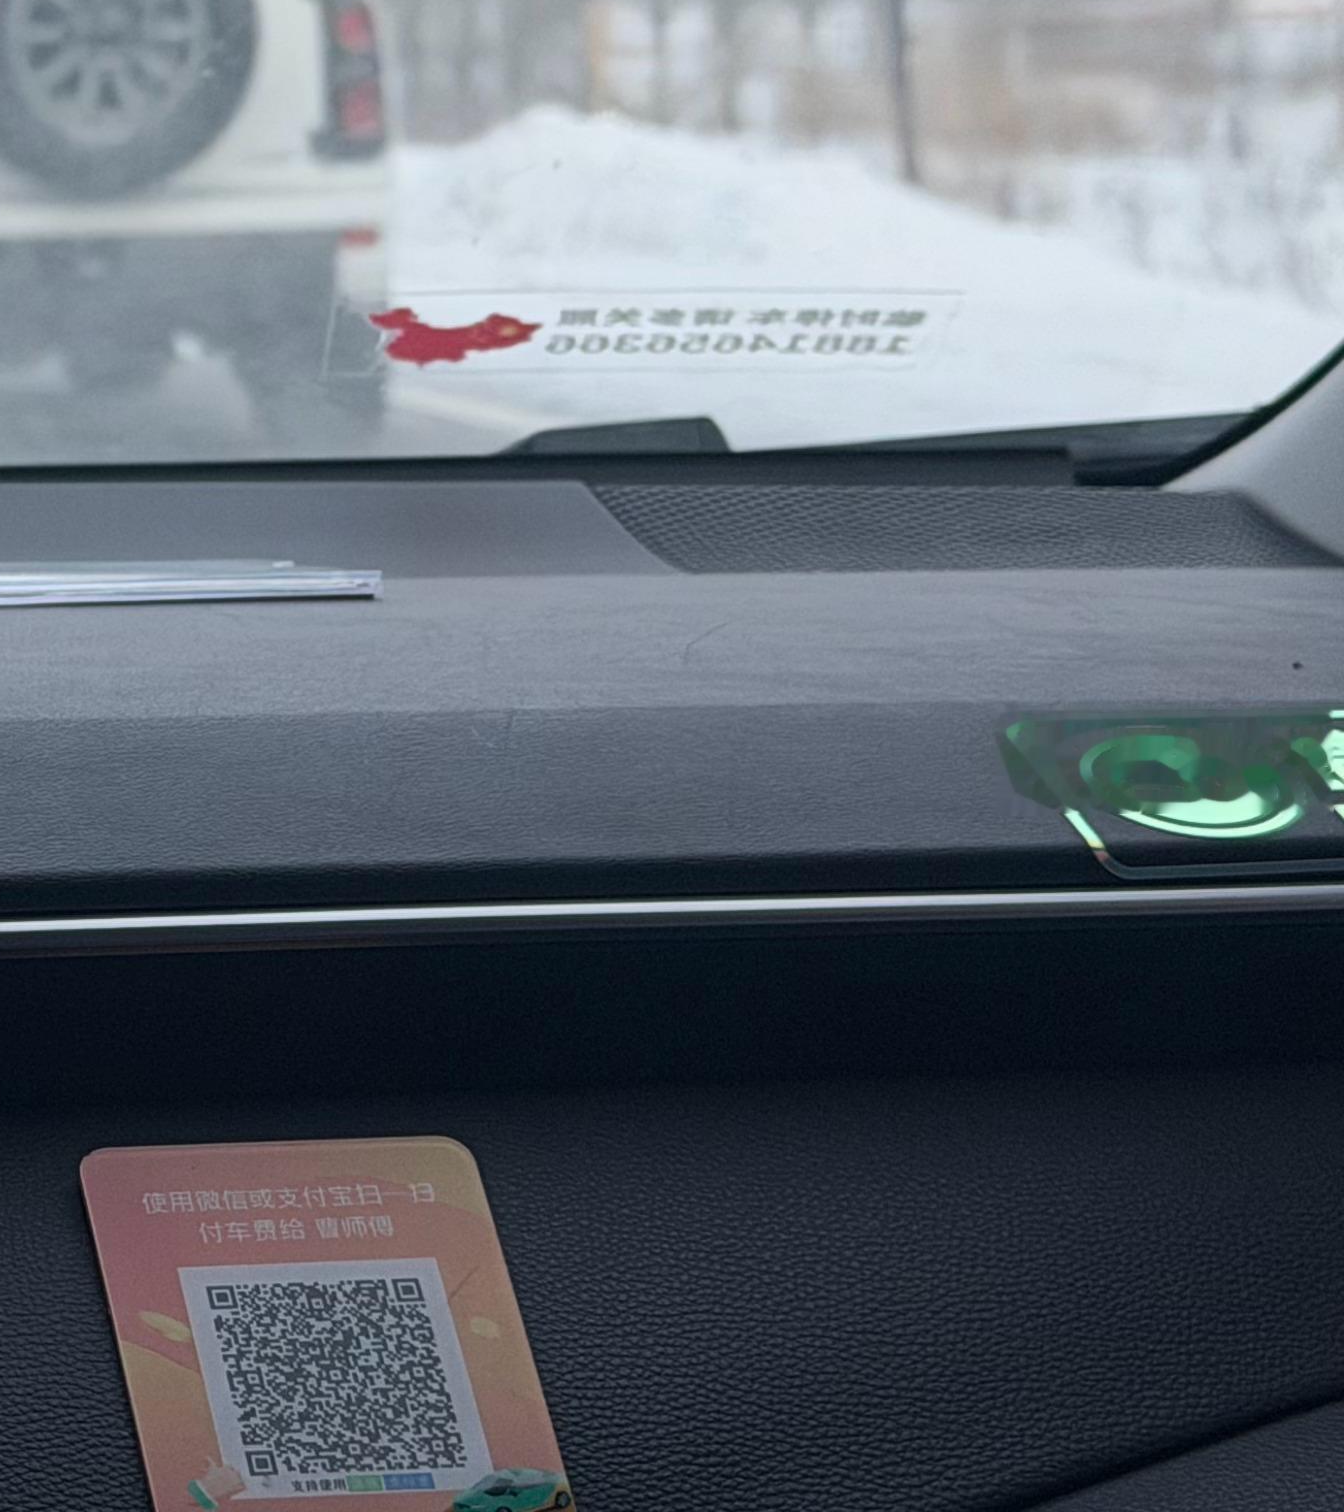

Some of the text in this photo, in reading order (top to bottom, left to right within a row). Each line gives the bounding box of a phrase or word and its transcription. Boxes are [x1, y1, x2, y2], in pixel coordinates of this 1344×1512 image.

[142, 1182, 435, 1215] 使用微信或支付宝扫一扫
[198, 1218, 305, 1244] 付车费给
